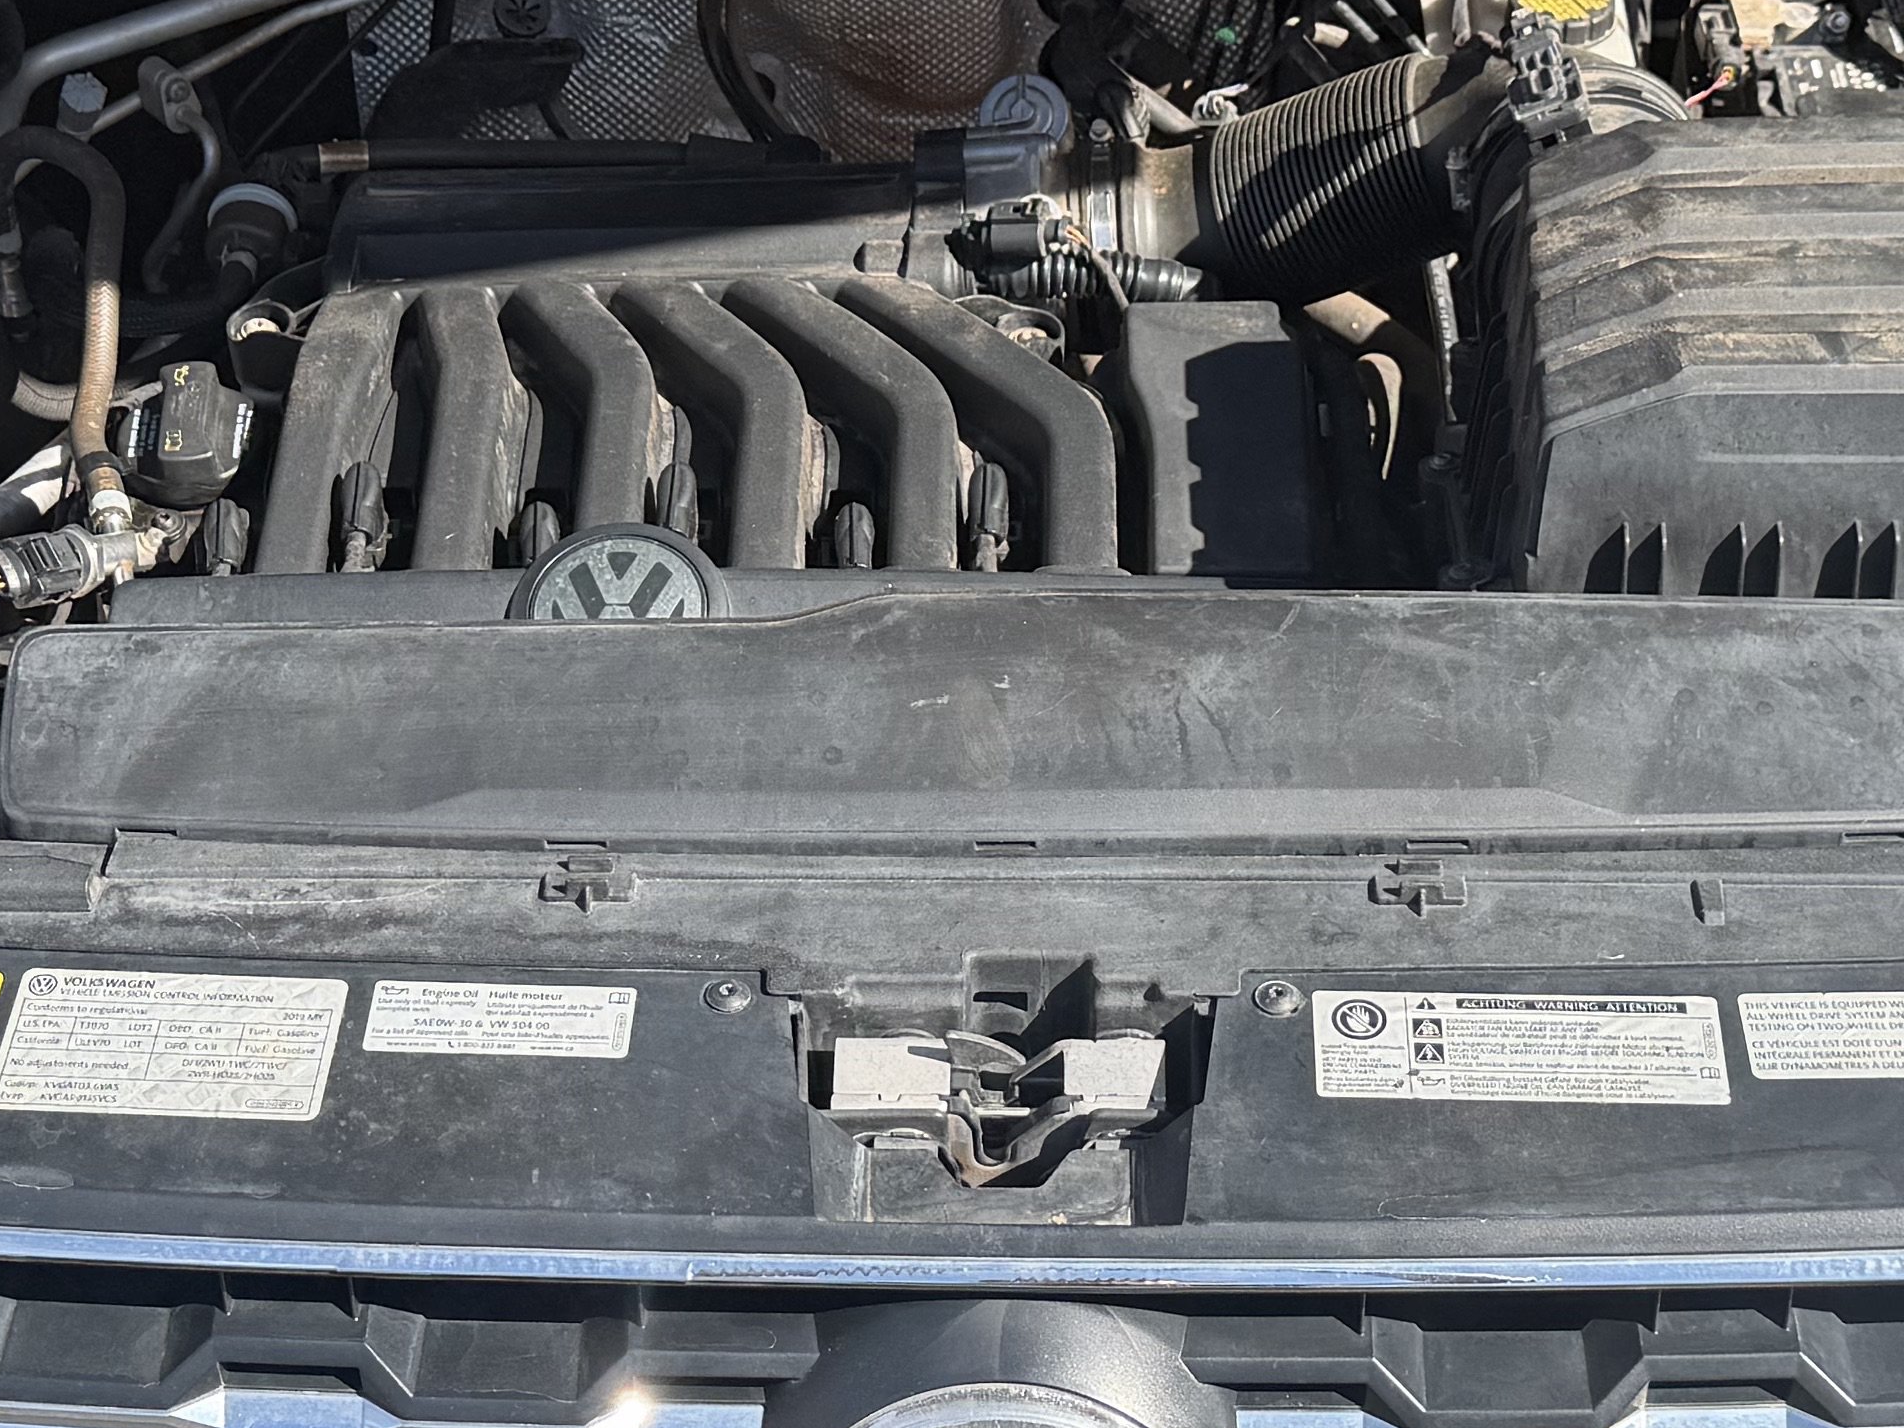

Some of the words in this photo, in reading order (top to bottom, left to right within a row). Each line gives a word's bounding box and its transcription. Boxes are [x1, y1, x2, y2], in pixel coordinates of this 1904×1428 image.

[63, 977, 156, 989] VOLKSWAGEN
[60, 988, 99, 997] VEHICLE
[103, 990, 150, 998] EMISSION
[154, 991, 199, 1001] CONTROL
[204, 993, 274, 1003] INFORMATION
[422, 988, 460, 999] Engine
[463, 990, 479, 998] Oil
[489, 990, 519, 1000] Huile
[521, 992, 564, 1001] moteur
[1462, 999, 1526, 1009] ACHTUNG
[1534, 1000, 1599, 1012] WARNING
[1606, 1003, 1678, 1012] ATTENTION
[1745, 1002, 1770, 1010] THIS
[1771, 1001, 1817, 1010] VEHICLE
[1832, 1000, 1887, 1010] EQUIPPED
[306, 1013, 324, 1021] MY
[1810, 1011, 1842, 1020] DRIVE
[1844, 1011, 1886, 1020] SYSTEM
[413, 1018, 435, 1027] SAE
[490, 1021, 509, 1029] VW
[511, 1021, 533, 1030] 504
[1749, 1023, 1795, 1032] TESTING
[1797, 1022, 1815, 1031] ON
[277, 1029, 320, 1038] Gasoline
[16, 1036, 61, 1045] California
[1767, 1039, 1819, 1048] VÉHICULE
[1821, 1040, 1840, 1048] EST
[1843, 1039, 1871, 1048] DOTÉ
[1874, 1039, 1902, 1047] D'UN
[272, 1046, 316, 1054] Gasoline
[1754, 1050, 1811, 1060] INTÉGRALE
[1812, 1050, 1878, 1059] PERMANENT
[27, 1059, 89, 1069] adjustments
[1755, 1061, 1779, 1071] SUR
